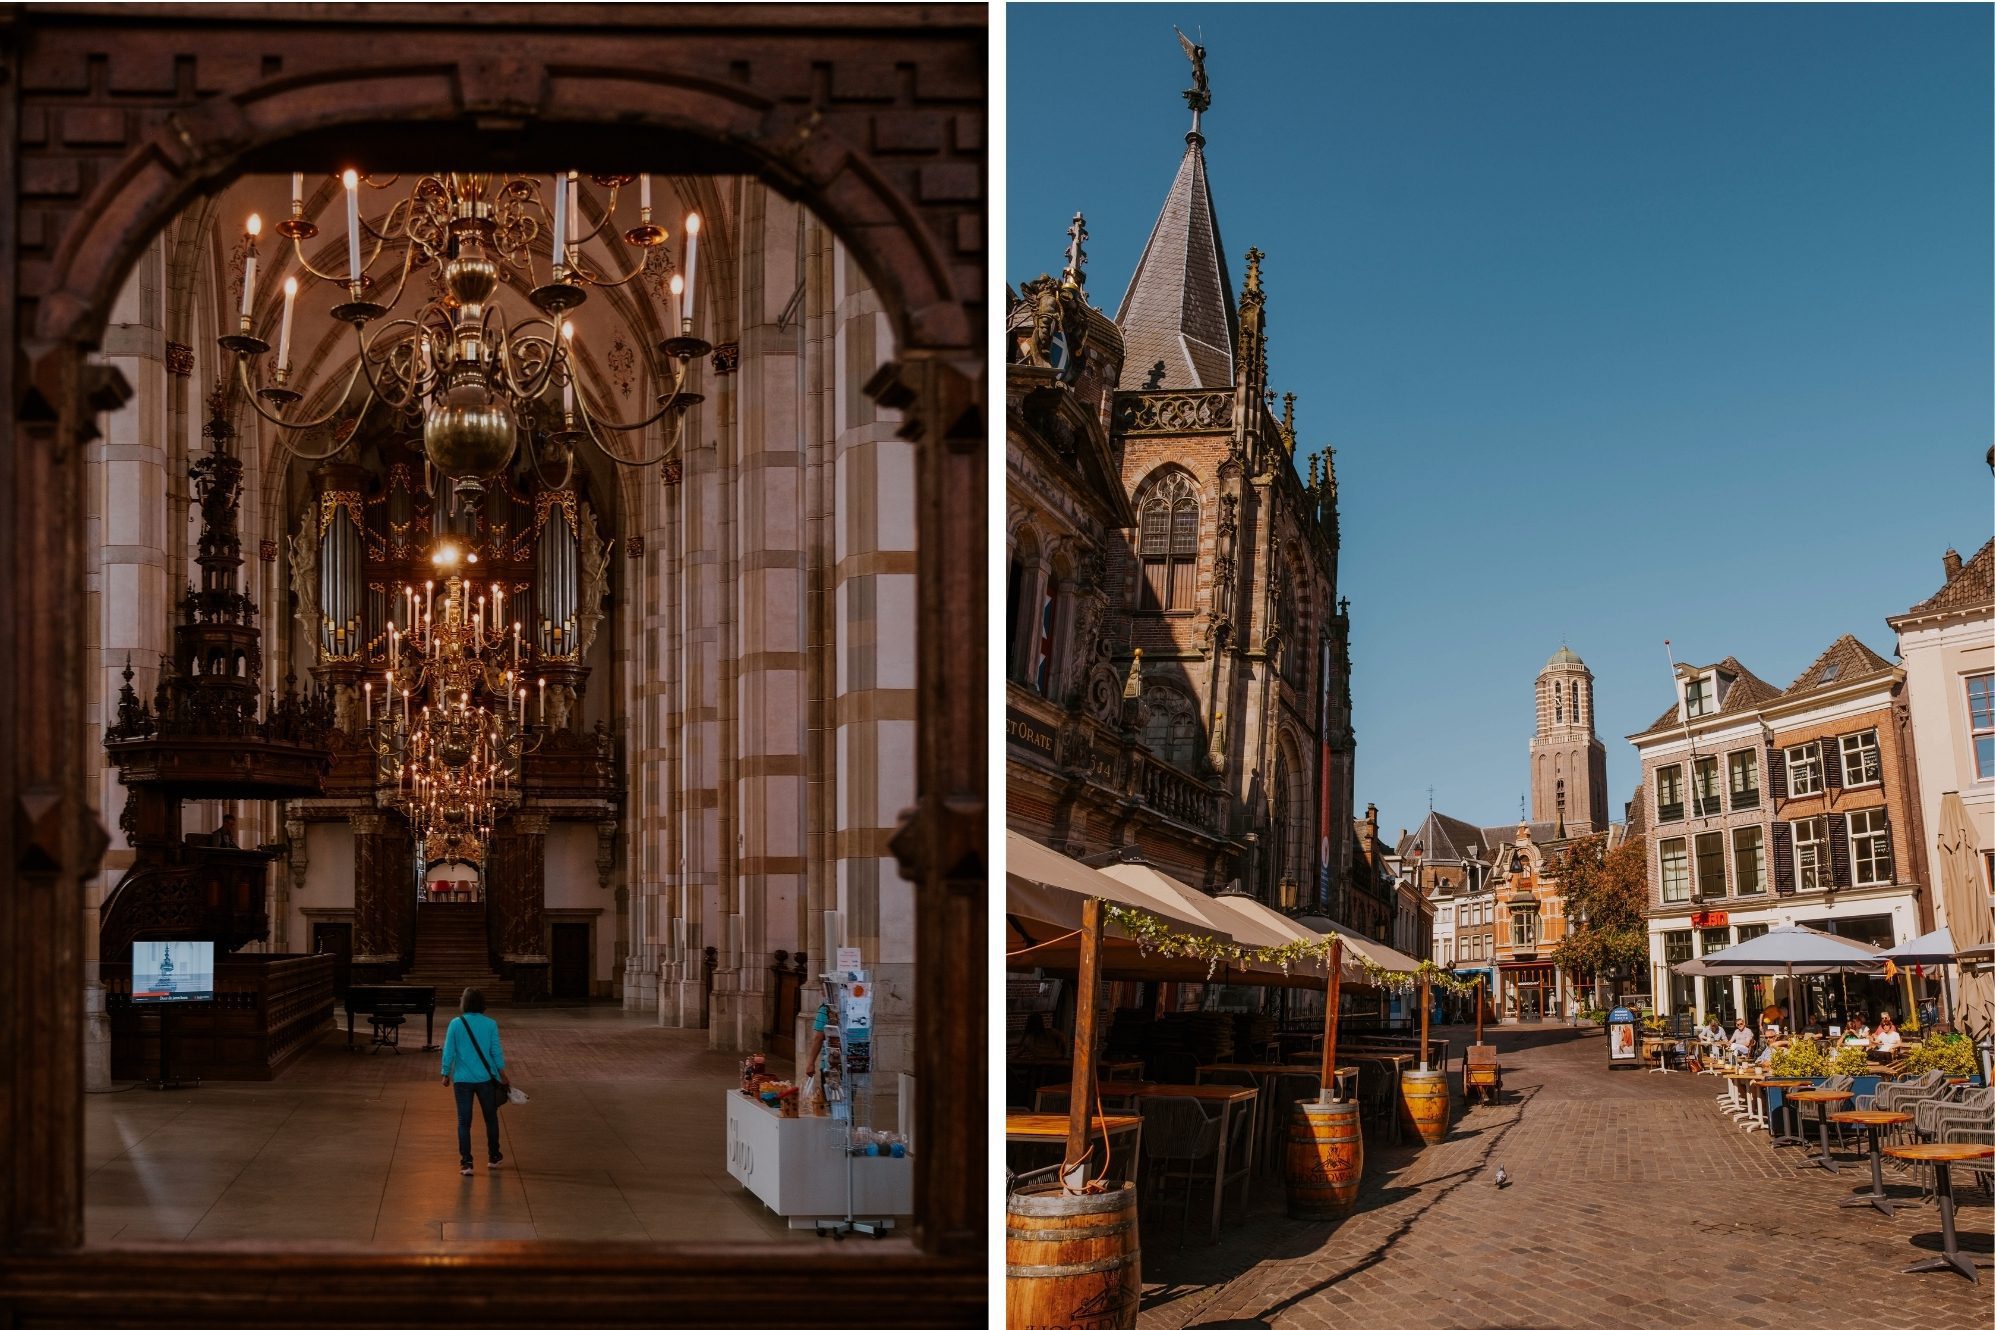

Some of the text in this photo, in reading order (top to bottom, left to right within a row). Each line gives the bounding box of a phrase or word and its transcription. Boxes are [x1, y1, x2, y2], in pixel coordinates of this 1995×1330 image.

[1018, 722, 1053, 750] ORATE
[1691, 911, 1728, 927] FBO
[730, 1117, 754, 1185] Shop
